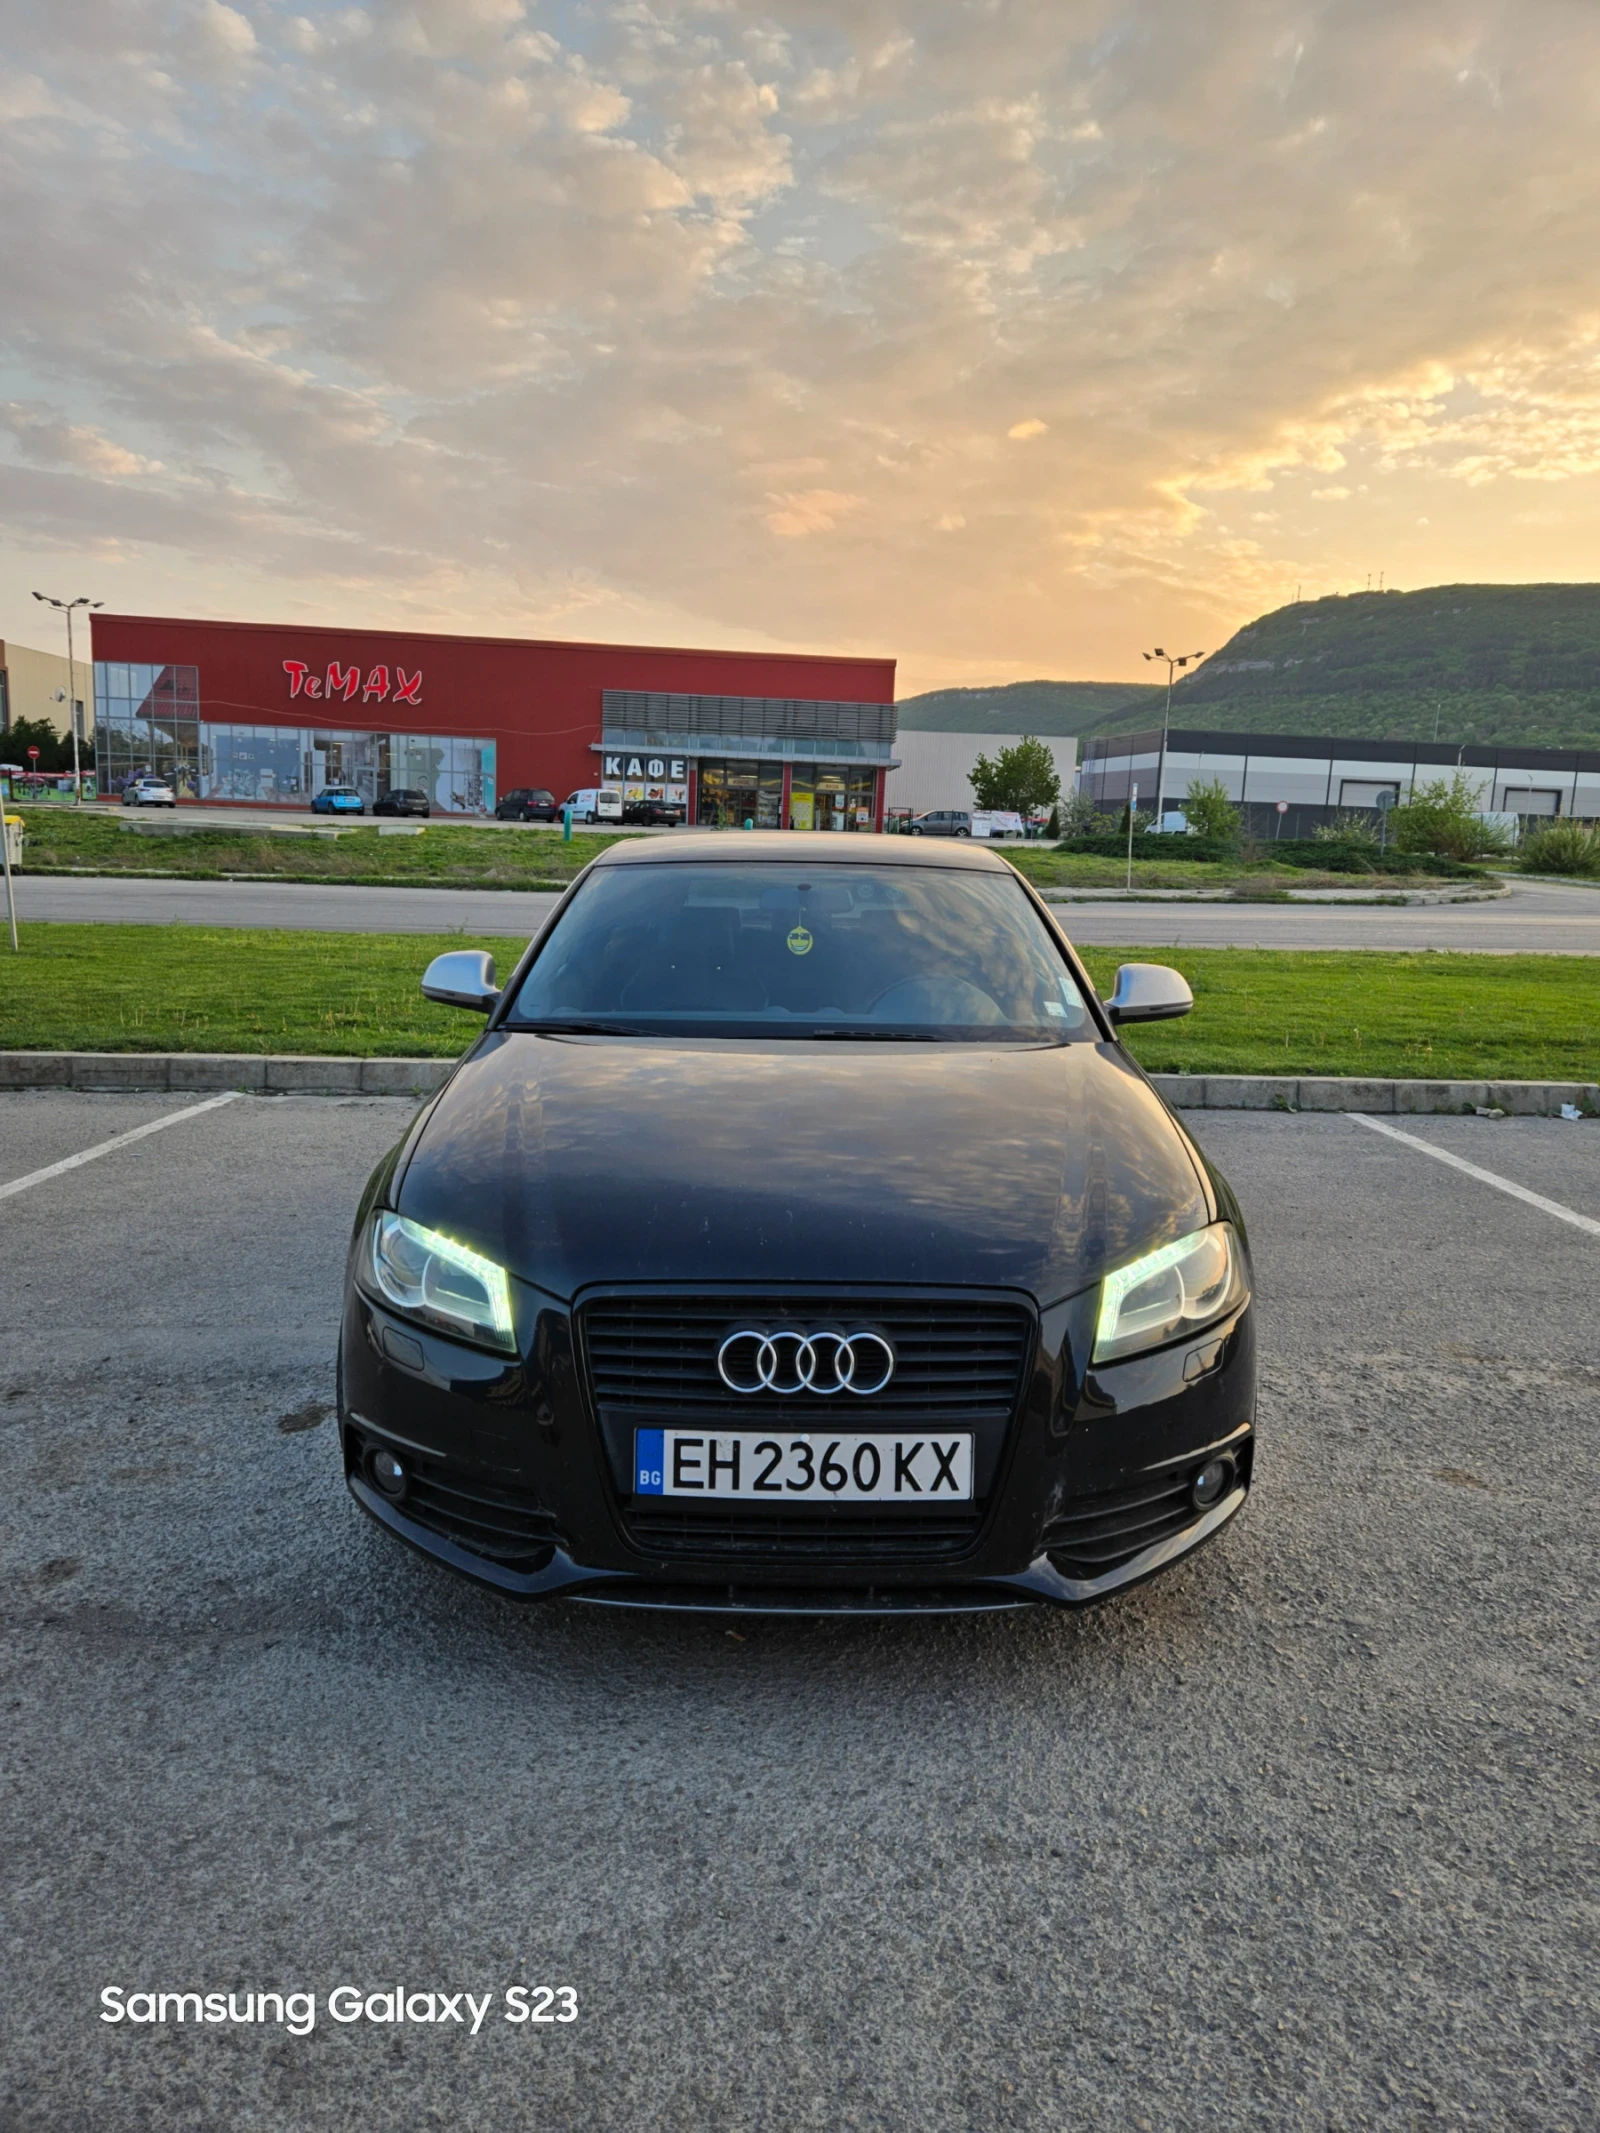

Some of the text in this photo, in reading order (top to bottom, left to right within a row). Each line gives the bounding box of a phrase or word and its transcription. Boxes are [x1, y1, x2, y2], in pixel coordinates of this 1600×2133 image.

[282, 660, 423, 705] TeMAX
[605, 756, 684, 778] КАФЕ
[640, 1469, 661, 1486] BG
